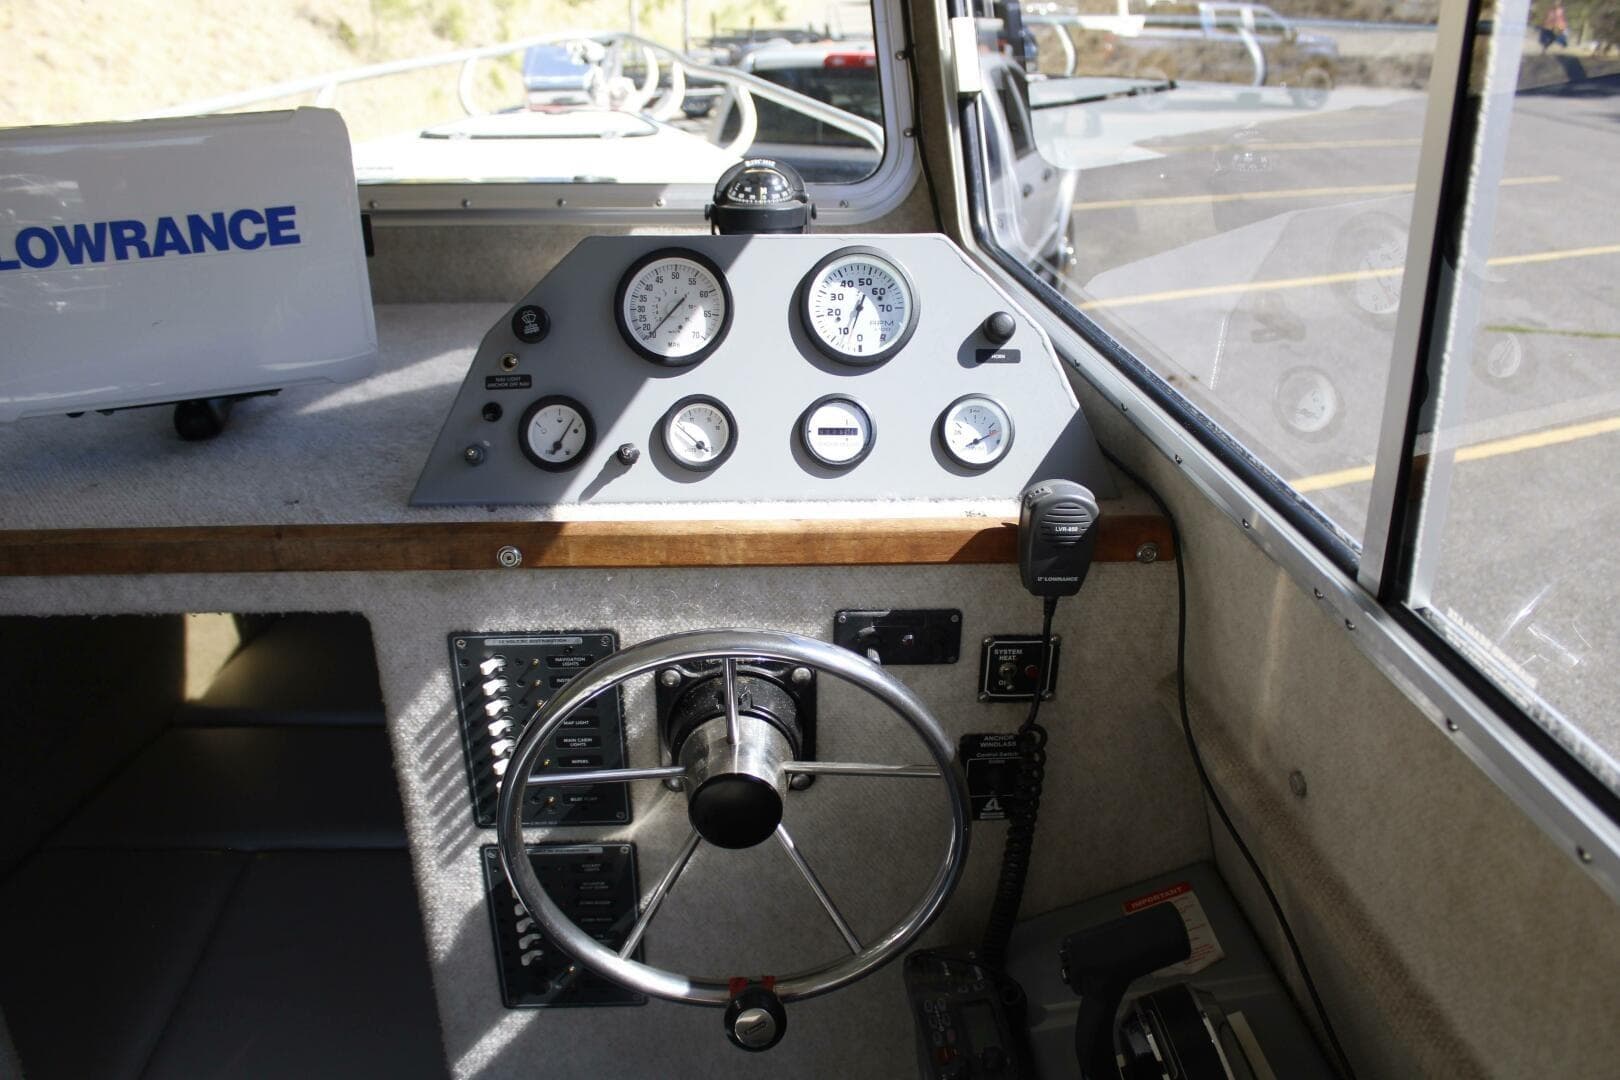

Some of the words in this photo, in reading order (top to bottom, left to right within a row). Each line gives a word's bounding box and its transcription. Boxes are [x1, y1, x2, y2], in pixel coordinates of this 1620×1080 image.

[655, 276, 664, 284] 45
[688, 277, 697, 286] 55
[839, 280, 854, 288] 40
[858, 278, 873, 286] 50
[644, 284, 653, 292] 40
[639, 294, 648, 303] 35
[830, 293, 844, 301] 30
[637, 305, 646, 313] 30
[827, 308, 841, 316] 20
[878, 304, 893, 312] 70
[703, 310, 712, 318] 65
[642, 323, 651, 331] 20
[838, 327, 849, 335] 10
[691, 331, 700, 339] 70
[856, 334, 863, 342] 0
[1130, 886, 1184, 909] IMPORTANT
